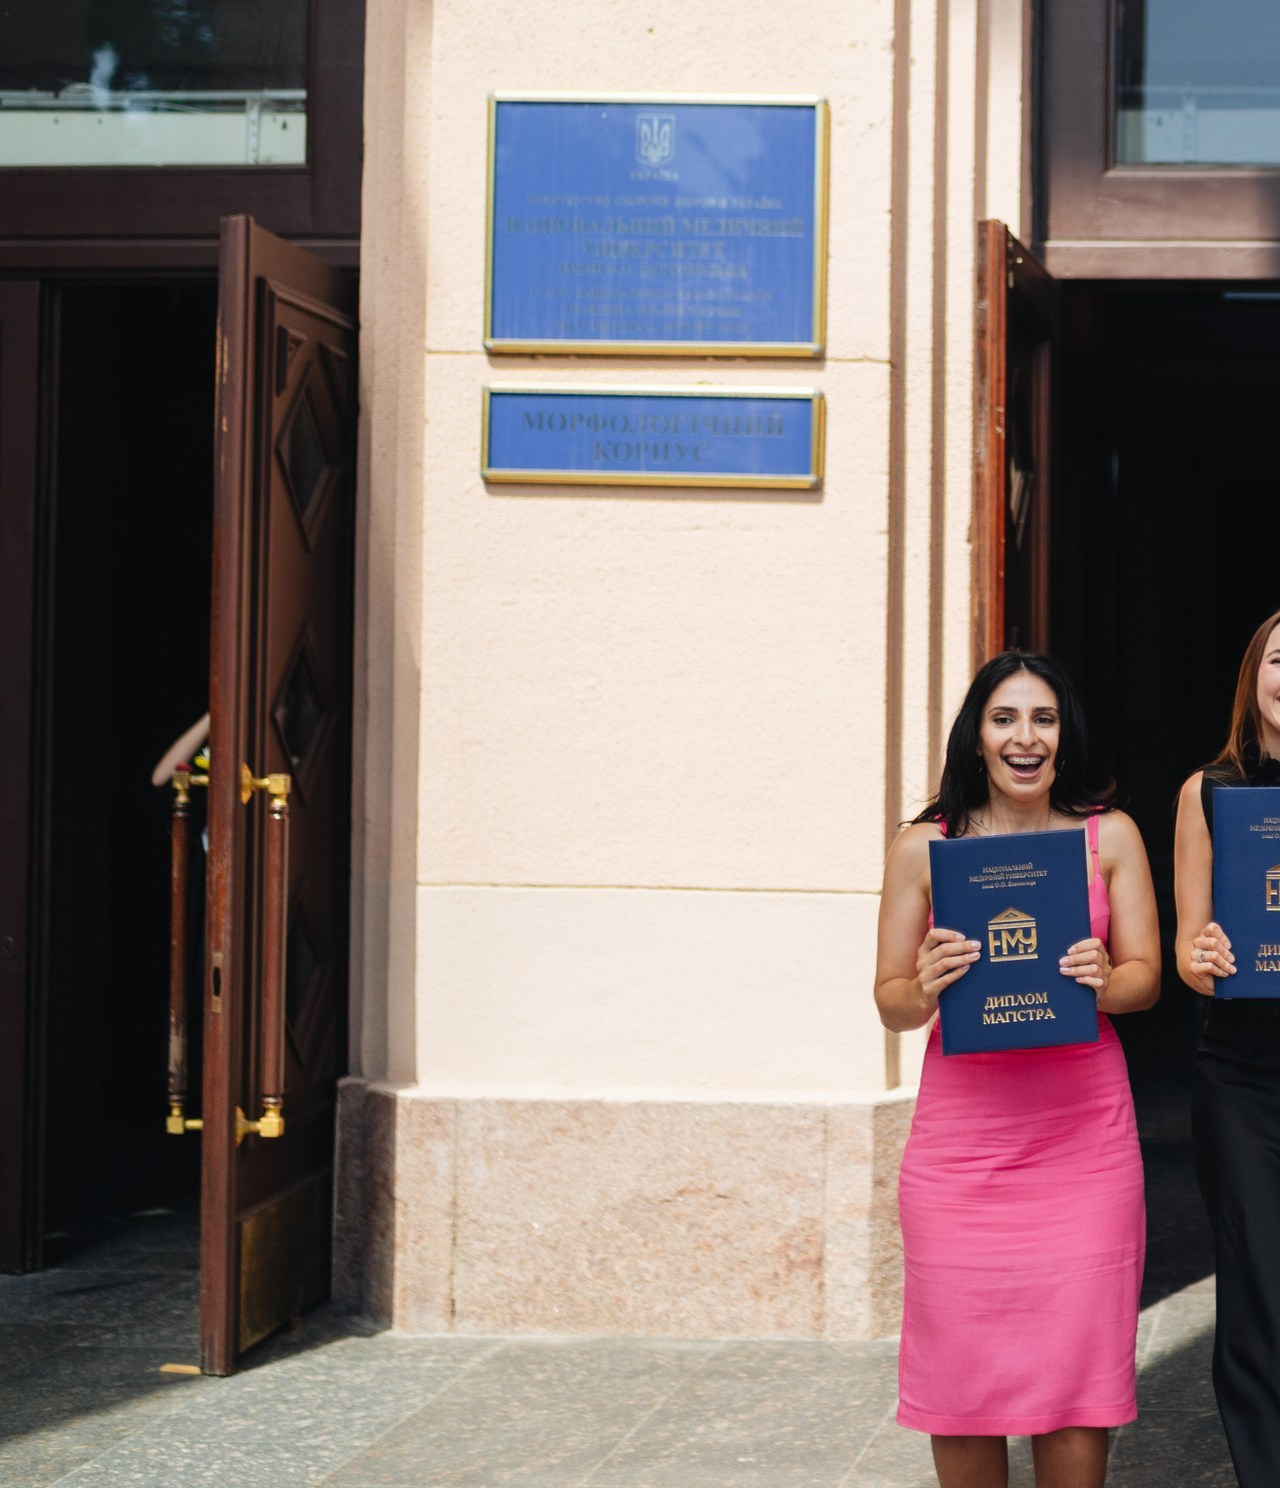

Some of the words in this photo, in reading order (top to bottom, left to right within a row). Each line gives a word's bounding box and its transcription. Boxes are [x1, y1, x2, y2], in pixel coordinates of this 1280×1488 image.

[521, 410, 786, 438] МОРФОЛОГІЧНИЙ
[593, 441, 711, 464] КОРПУС
[984, 992, 1048, 1010] ДИПЛОМ
[982, 1008, 1056, 1025] МАГІСТРА
